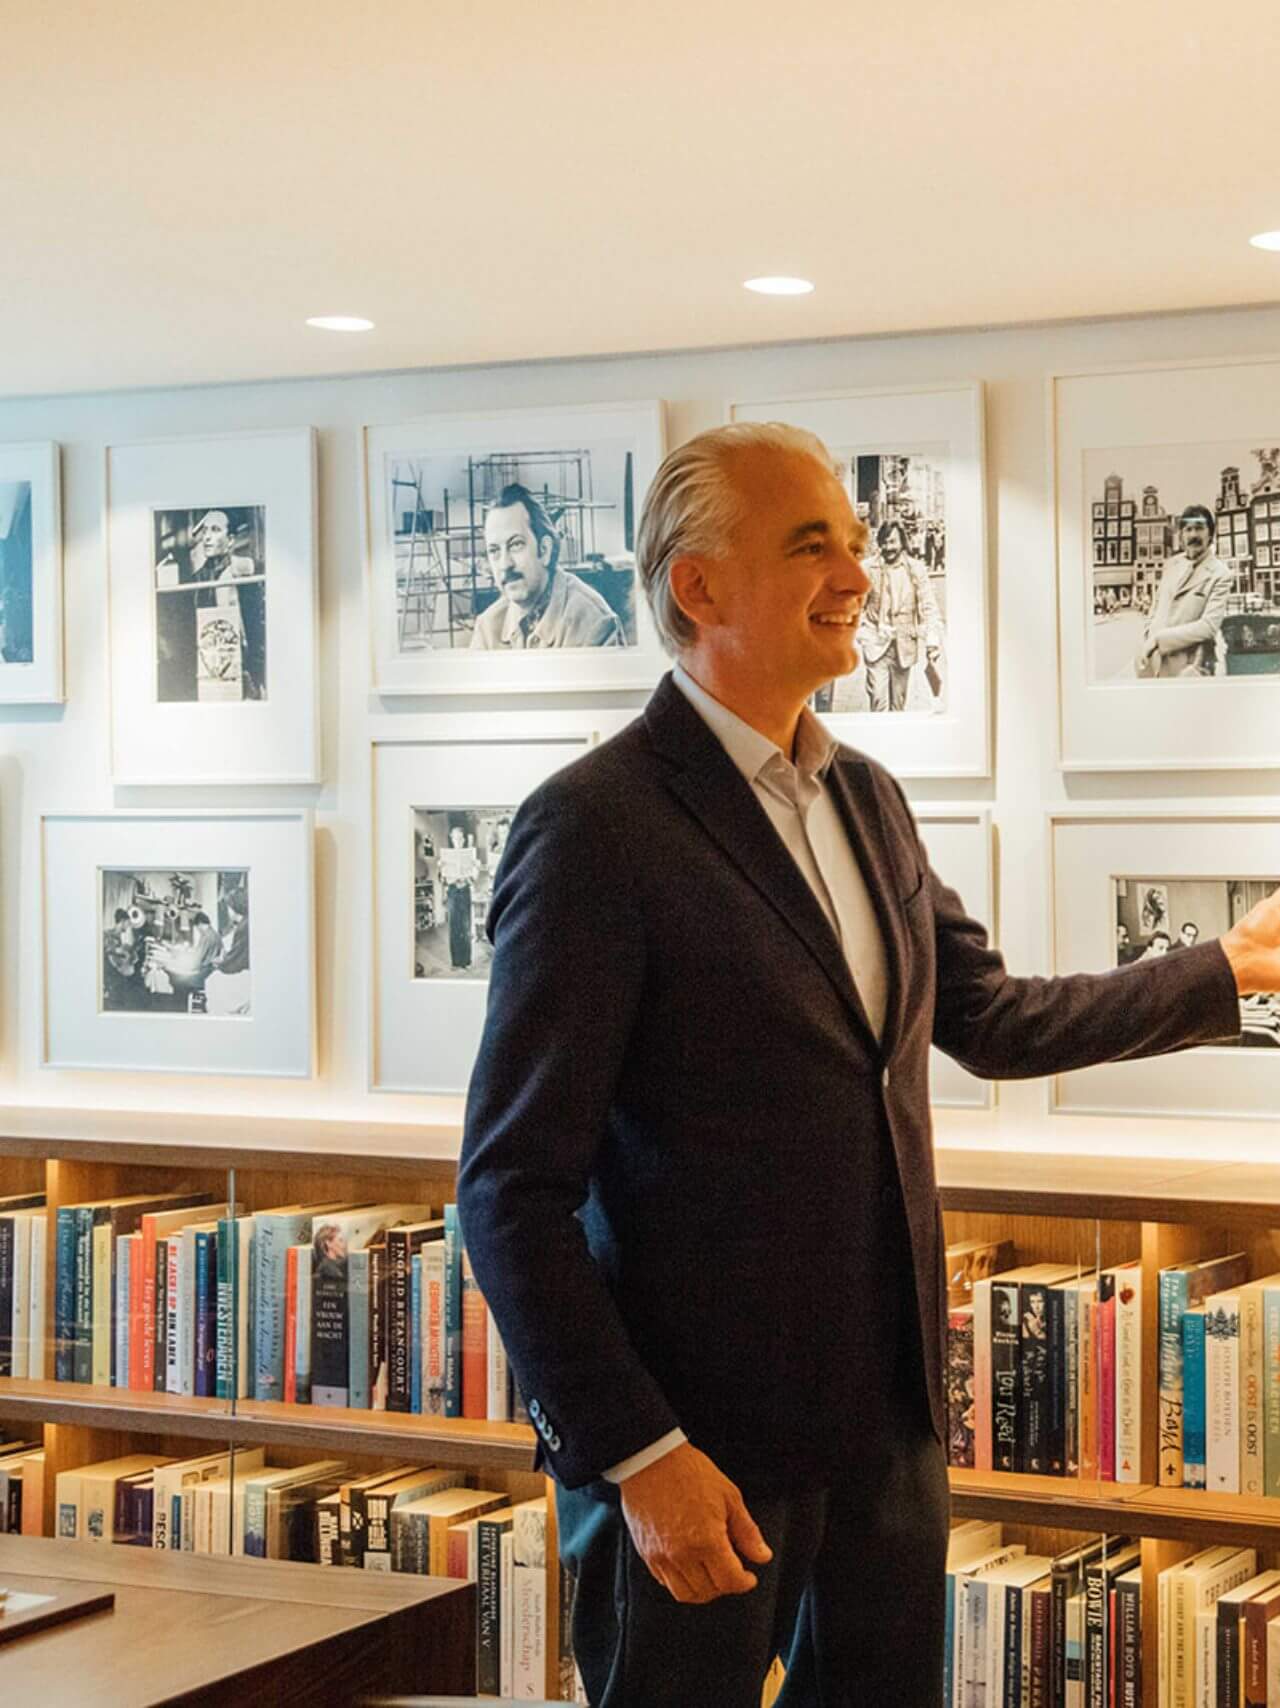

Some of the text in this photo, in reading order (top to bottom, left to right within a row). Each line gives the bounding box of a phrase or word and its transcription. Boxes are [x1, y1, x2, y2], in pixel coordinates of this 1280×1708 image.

[168, 1261, 176, 1292] JACHT
[1171, 1279, 1179, 1299] The
[168, 1296, 176, 1309] OP
[168, 1312, 176, 1329] BIN
[396, 1242, 404, 1394] INGRID BETANCOURT
[168, 1333, 176, 1365] LADEN
[1270, 1307, 1280, 1434] VERLOREN NACHTEN
[995, 1370, 1016, 1444] Lou Reed
[1224, 1346, 1232, 1436] JOSEPH BOYDEN
[1247, 1374, 1256, 1456] OOST IS OOST
[1160, 1398, 1183, 1453] Boyd
[481, 1526, 490, 1648] HET VERHAAL VAN V
[1087, 1577, 1103, 1627] BOWIE
[520, 1580, 532, 1671] Moederschap
[1010, 1613, 1016, 1622] de
[1126, 1593, 1134, 1643] WILLIAM
[1126, 1647, 1134, 1678] BOYD
